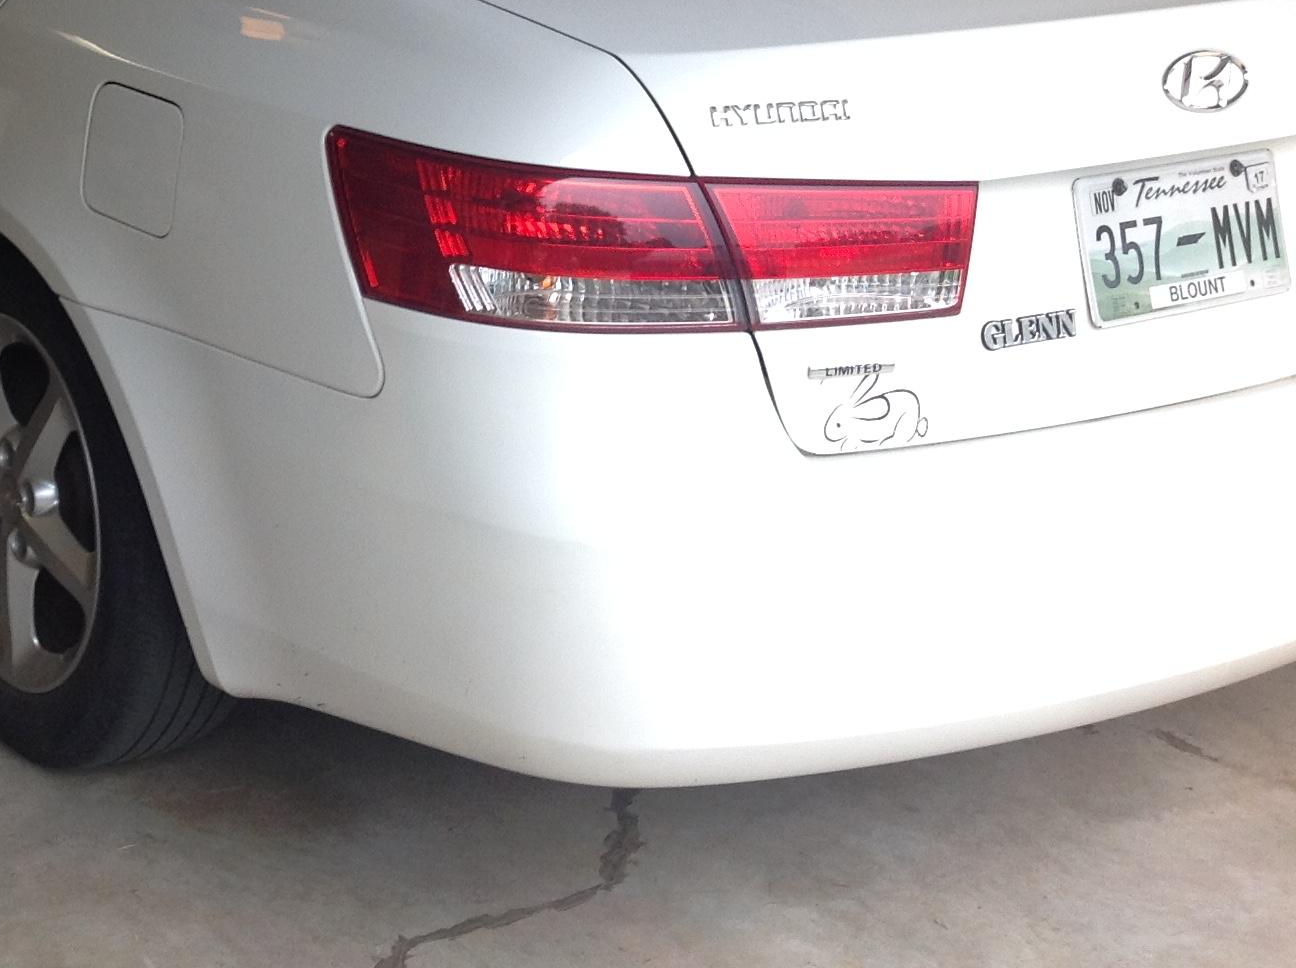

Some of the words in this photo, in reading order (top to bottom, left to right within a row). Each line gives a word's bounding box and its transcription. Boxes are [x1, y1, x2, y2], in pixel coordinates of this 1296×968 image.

[709, 99, 851, 127] HYUNDAI
[1254, 170, 1265, 184] 17
[1094, 190, 1115, 215] NOV
[1133, 175, 1228, 208] Tennessee
[1095, 215, 1163, 289] 357
[1210, 197, 1281, 270] MVM
[1169, 275, 1227, 303] BLOUNT
[981, 309, 1077, 351] GLENN
[825, 362, 883, 378] LIMITED
